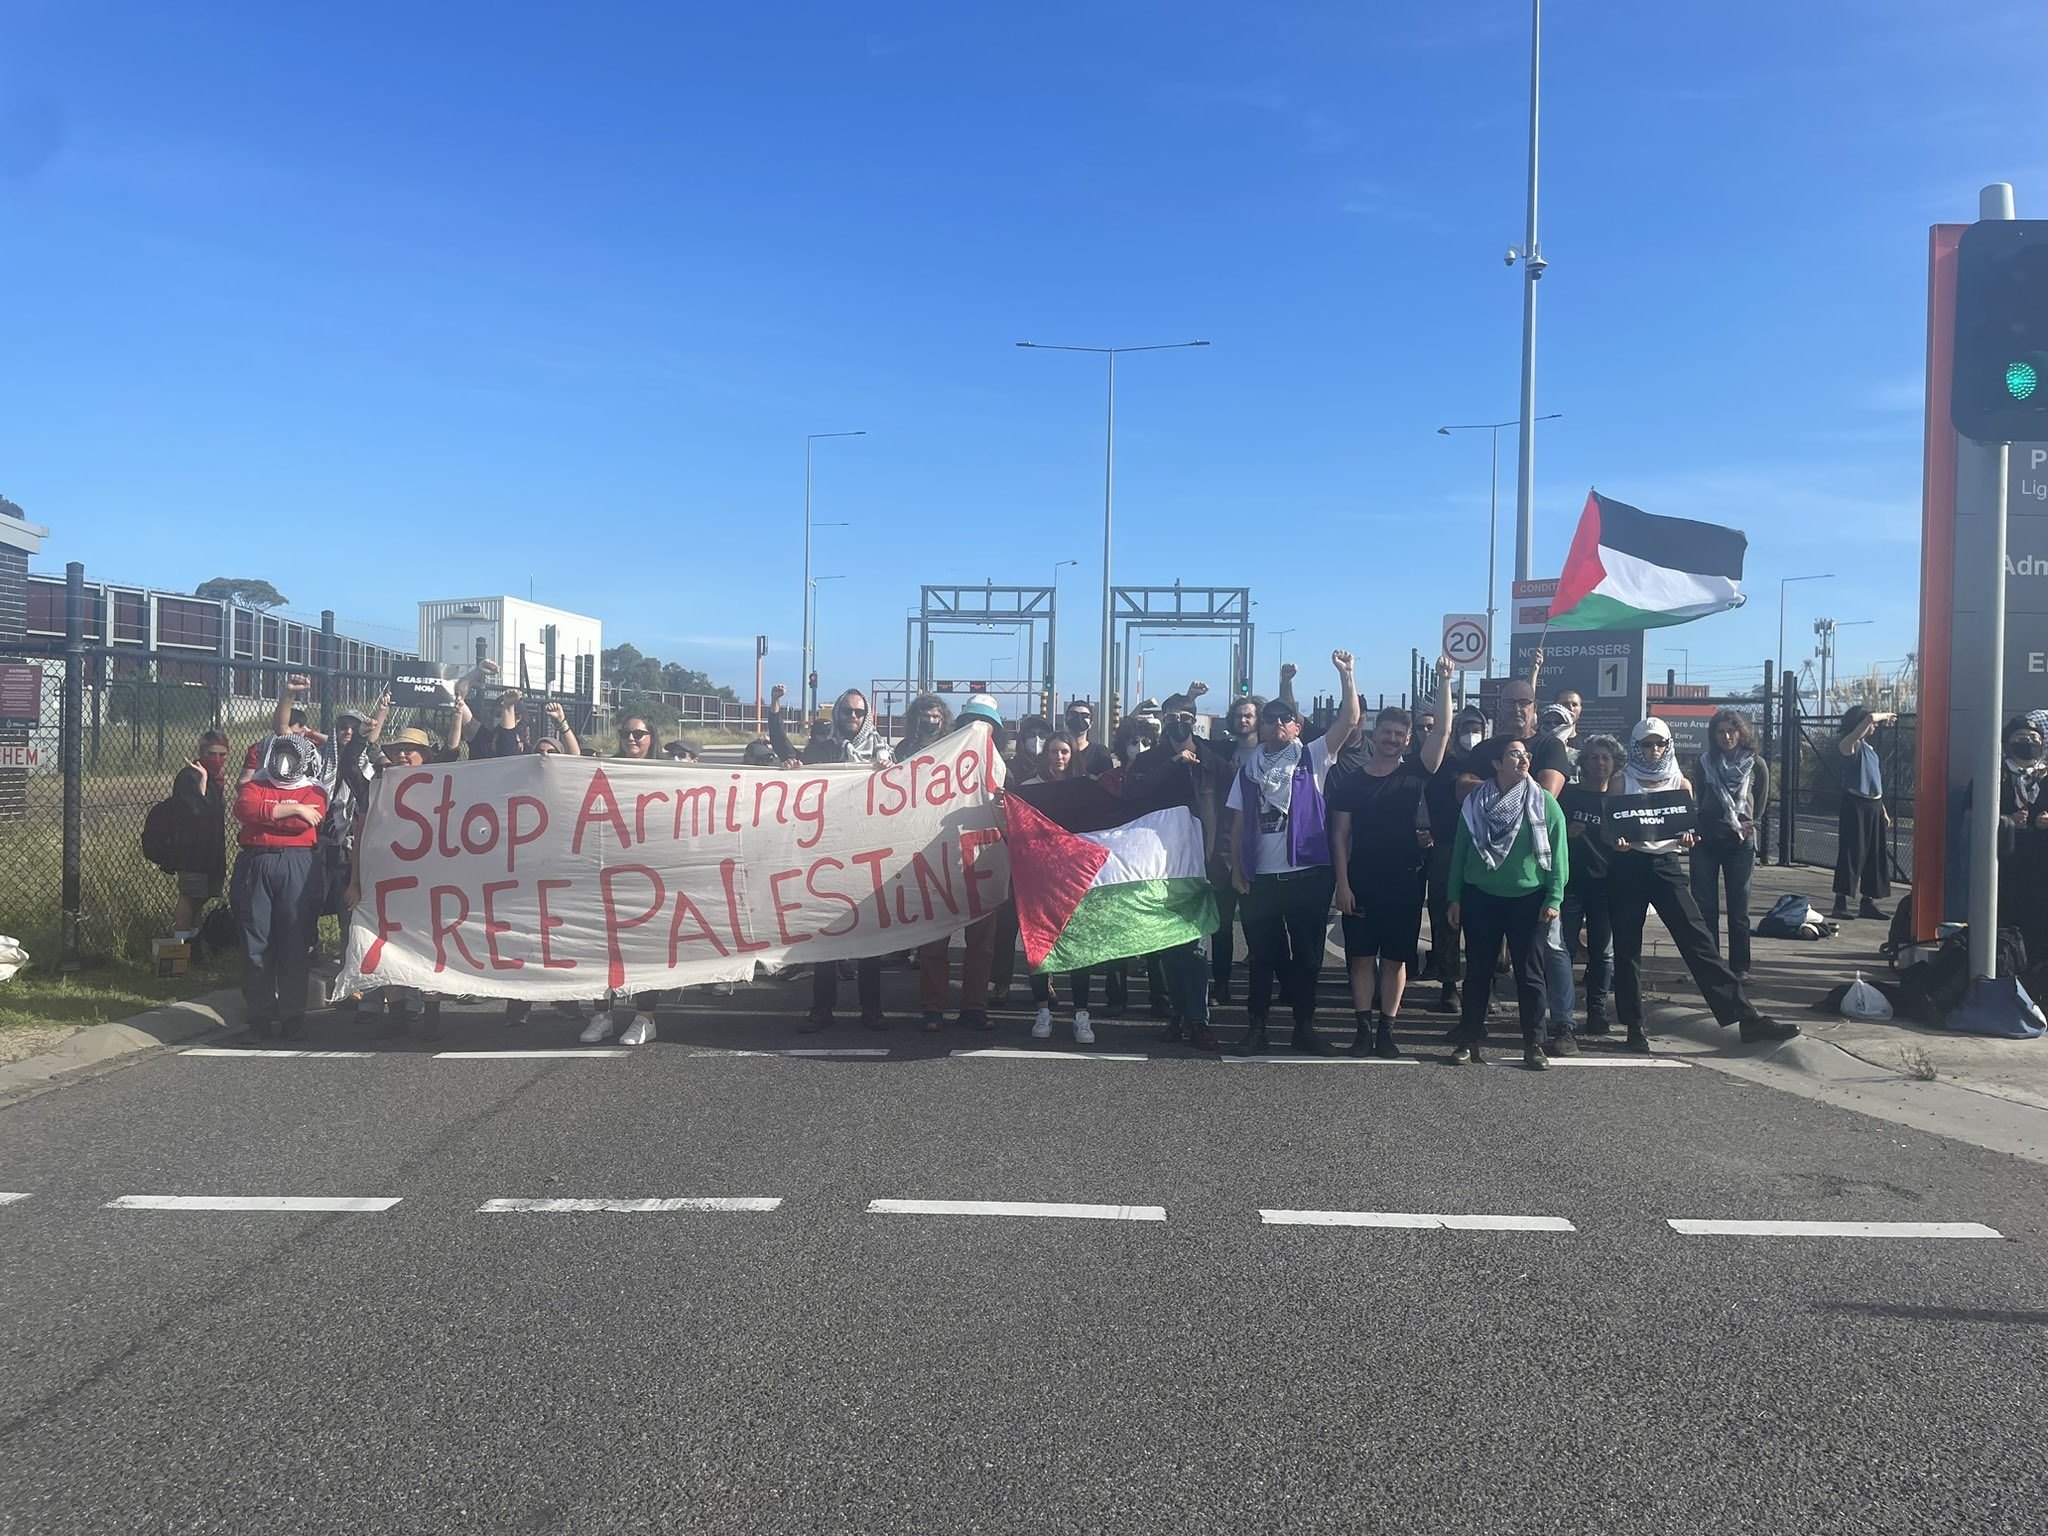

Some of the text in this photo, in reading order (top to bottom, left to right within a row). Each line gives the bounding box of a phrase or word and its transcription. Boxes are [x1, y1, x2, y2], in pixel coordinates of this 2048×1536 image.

[1520, 583, 1558, 593] CONDIT
[1450, 632, 1480, 652] 20
[1518, 666, 1565, 676] SERITY
[1605, 663, 1618, 692] 1
[414, 684, 436, 693] NOW
[1667, 720, 1710, 729] cure Area
[1674, 732, 1694, 741] Entry
[1674, 741, 1702, 750] ohibited
[0, 747, 39, 766] HEM
[1613, 805, 1688, 820] CEASEFIRE
[390, 772, 549, 873] Stop
[571, 767, 829, 849] Arming
[1639, 816, 1665, 825] NOW
[360, 875, 578, 975] FREE
